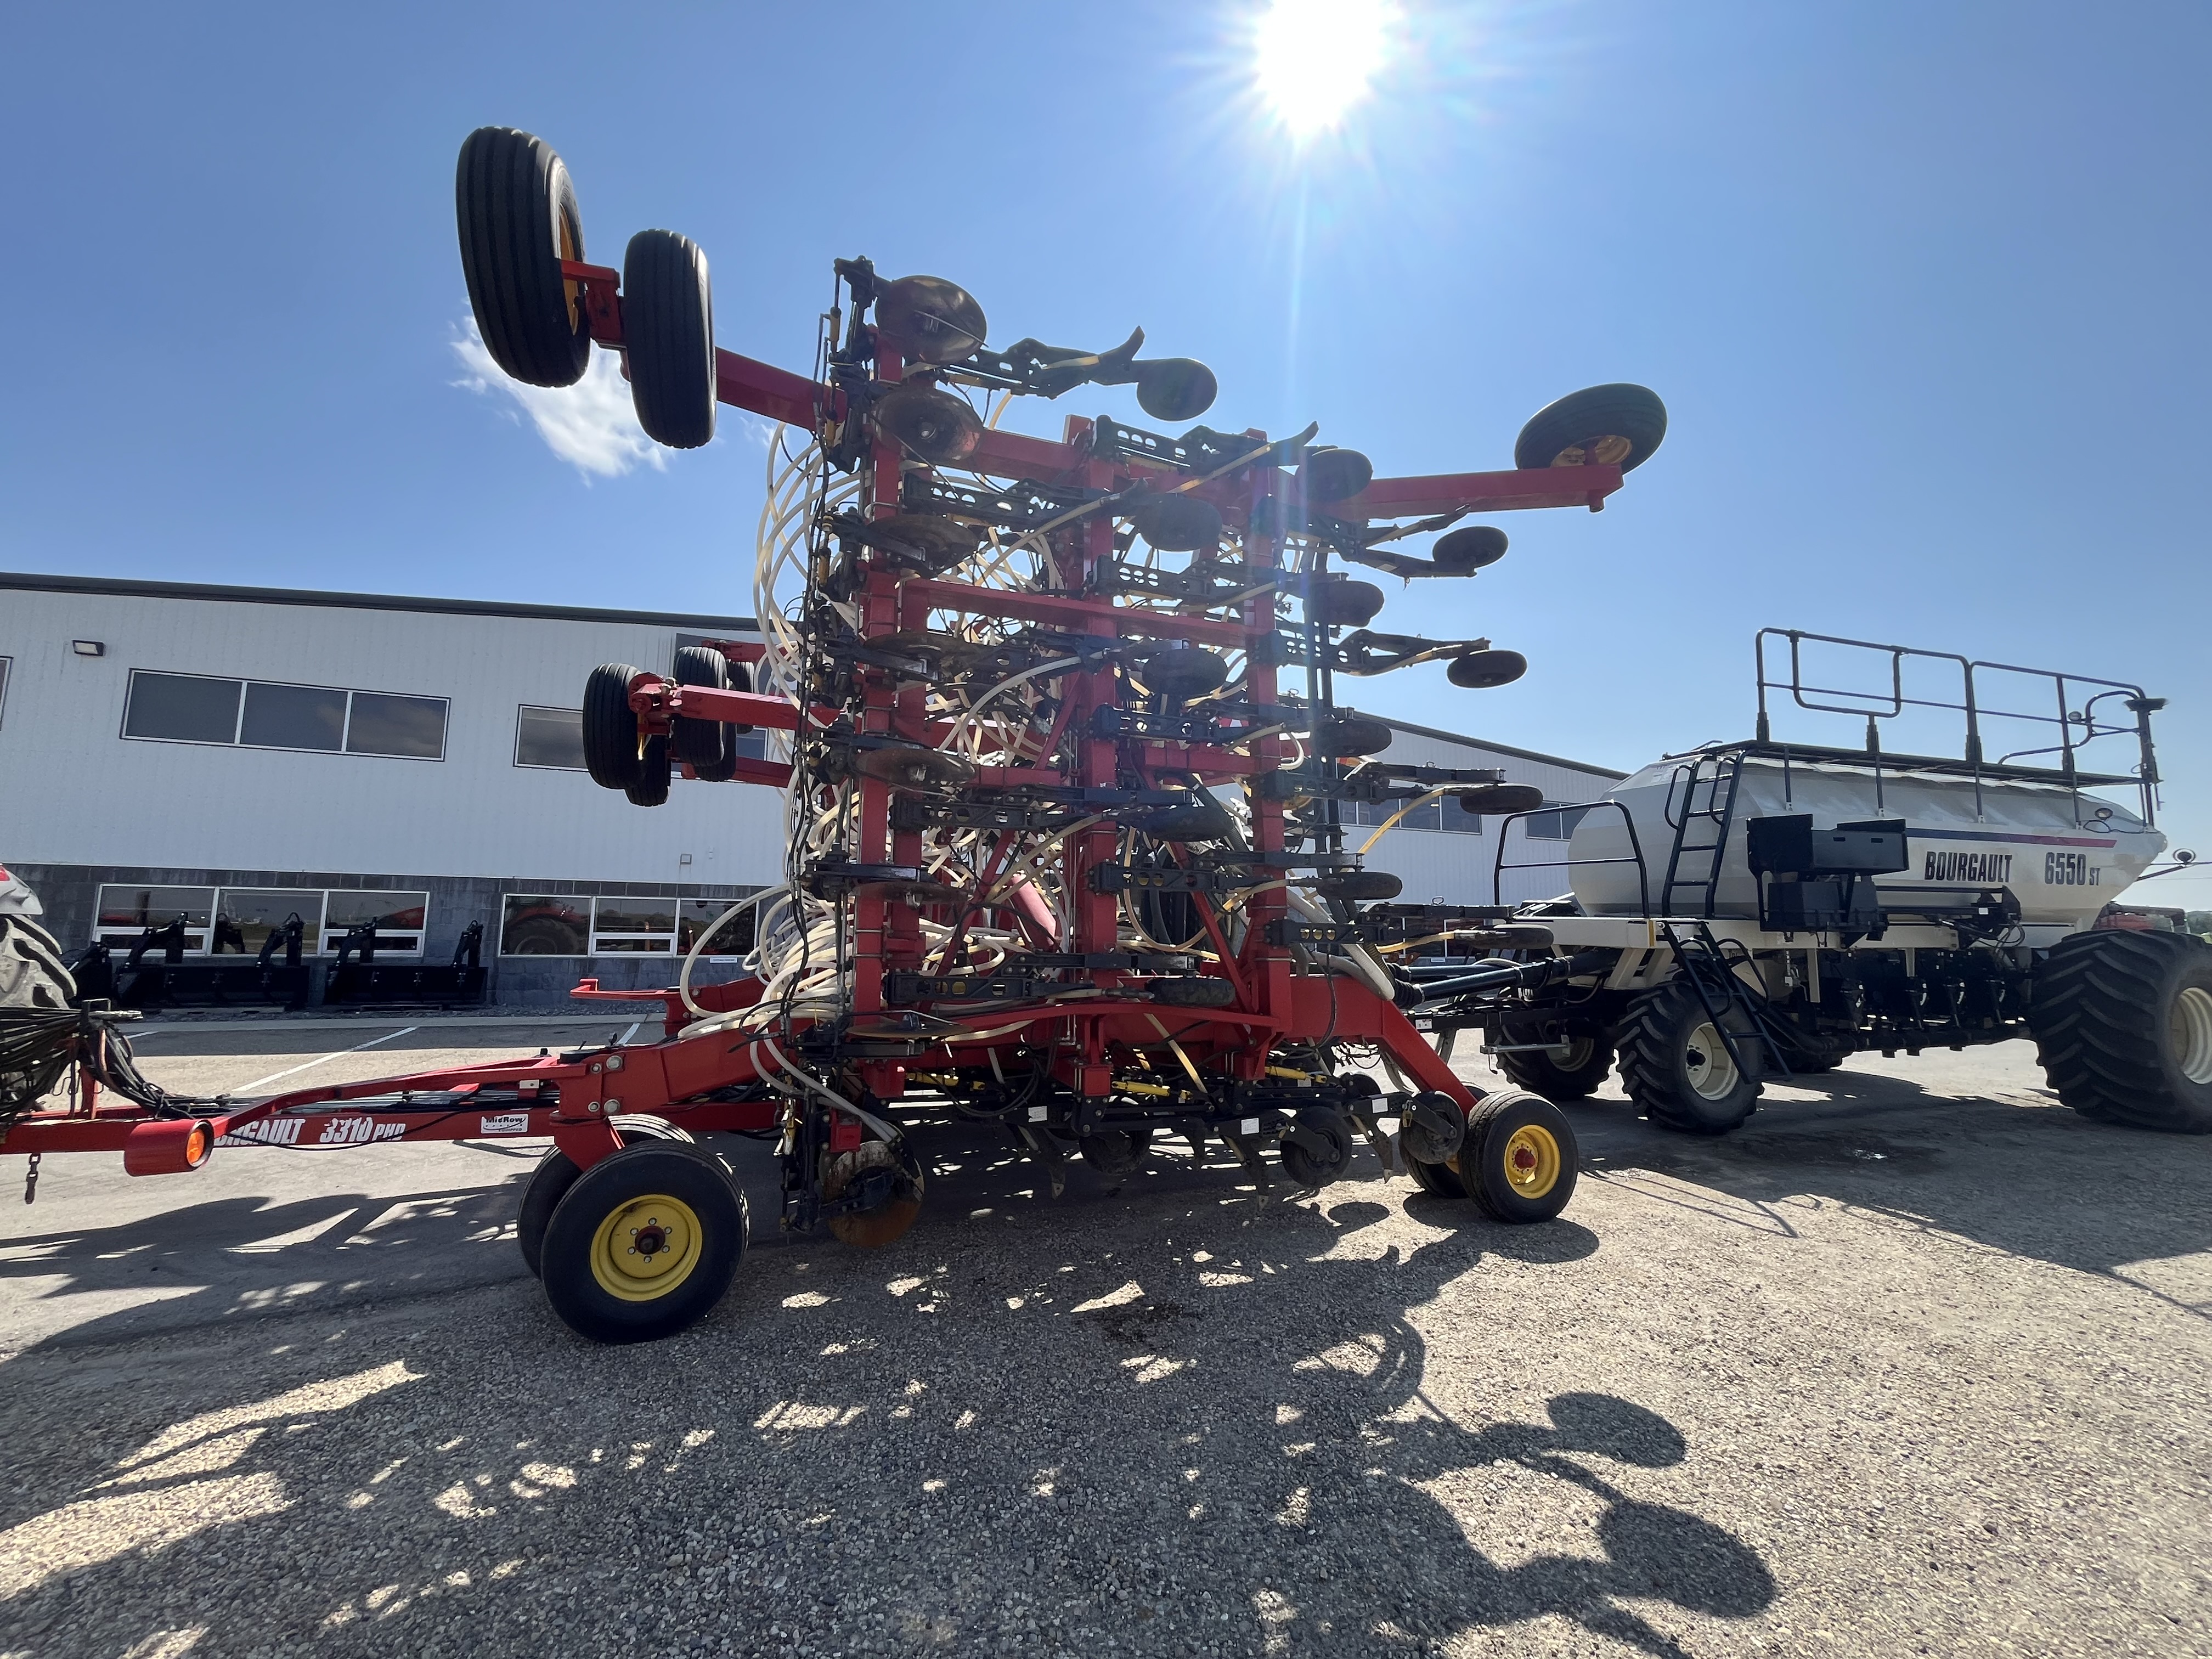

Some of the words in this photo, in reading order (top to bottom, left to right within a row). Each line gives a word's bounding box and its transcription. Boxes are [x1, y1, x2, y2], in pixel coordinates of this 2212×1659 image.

[1925, 851, 2013, 883] BOURGAULT
[2045, 852, 2086, 885] 6550
[2089, 867, 2100, 886] ST
[319, 1117, 374, 1143] 3310
